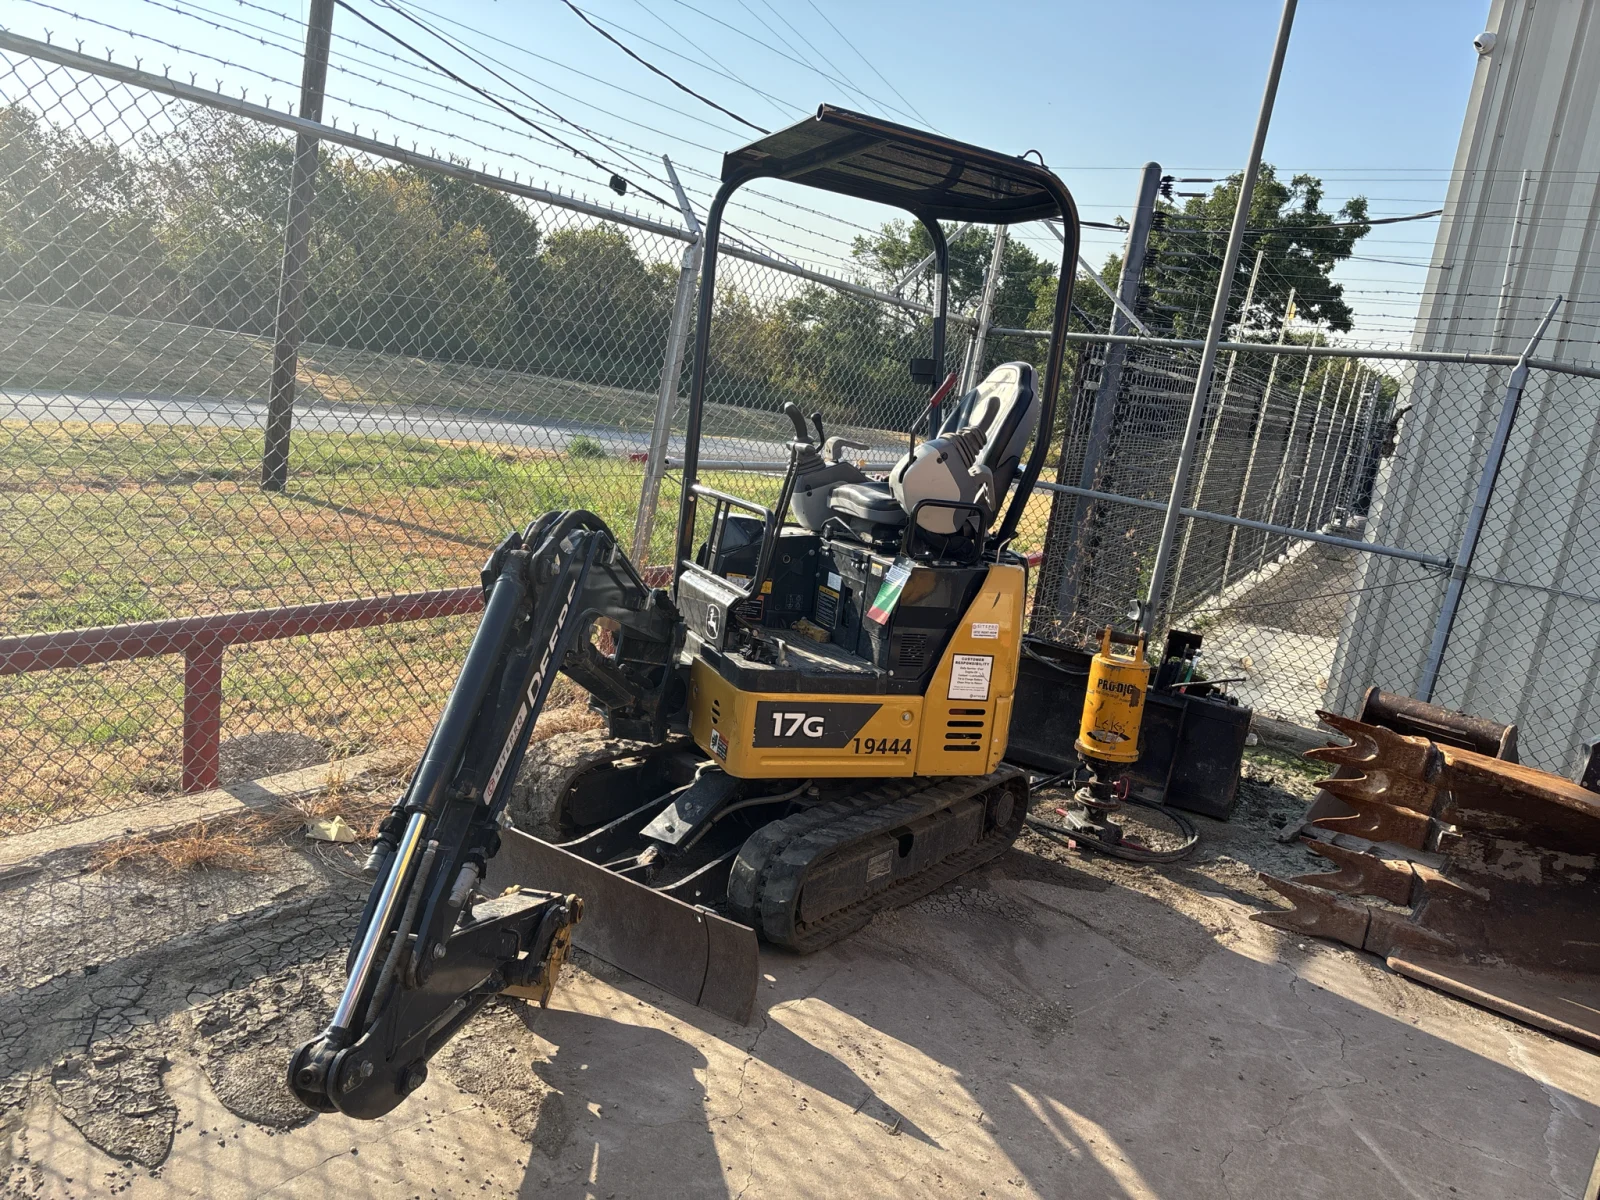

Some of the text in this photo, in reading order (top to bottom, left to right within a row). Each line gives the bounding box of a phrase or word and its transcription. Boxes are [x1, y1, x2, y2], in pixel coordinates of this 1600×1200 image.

[773, 713, 824, 737] 17G
[495, 712, 524, 777] SITEPRO
[854, 738, 912, 755] 19444
